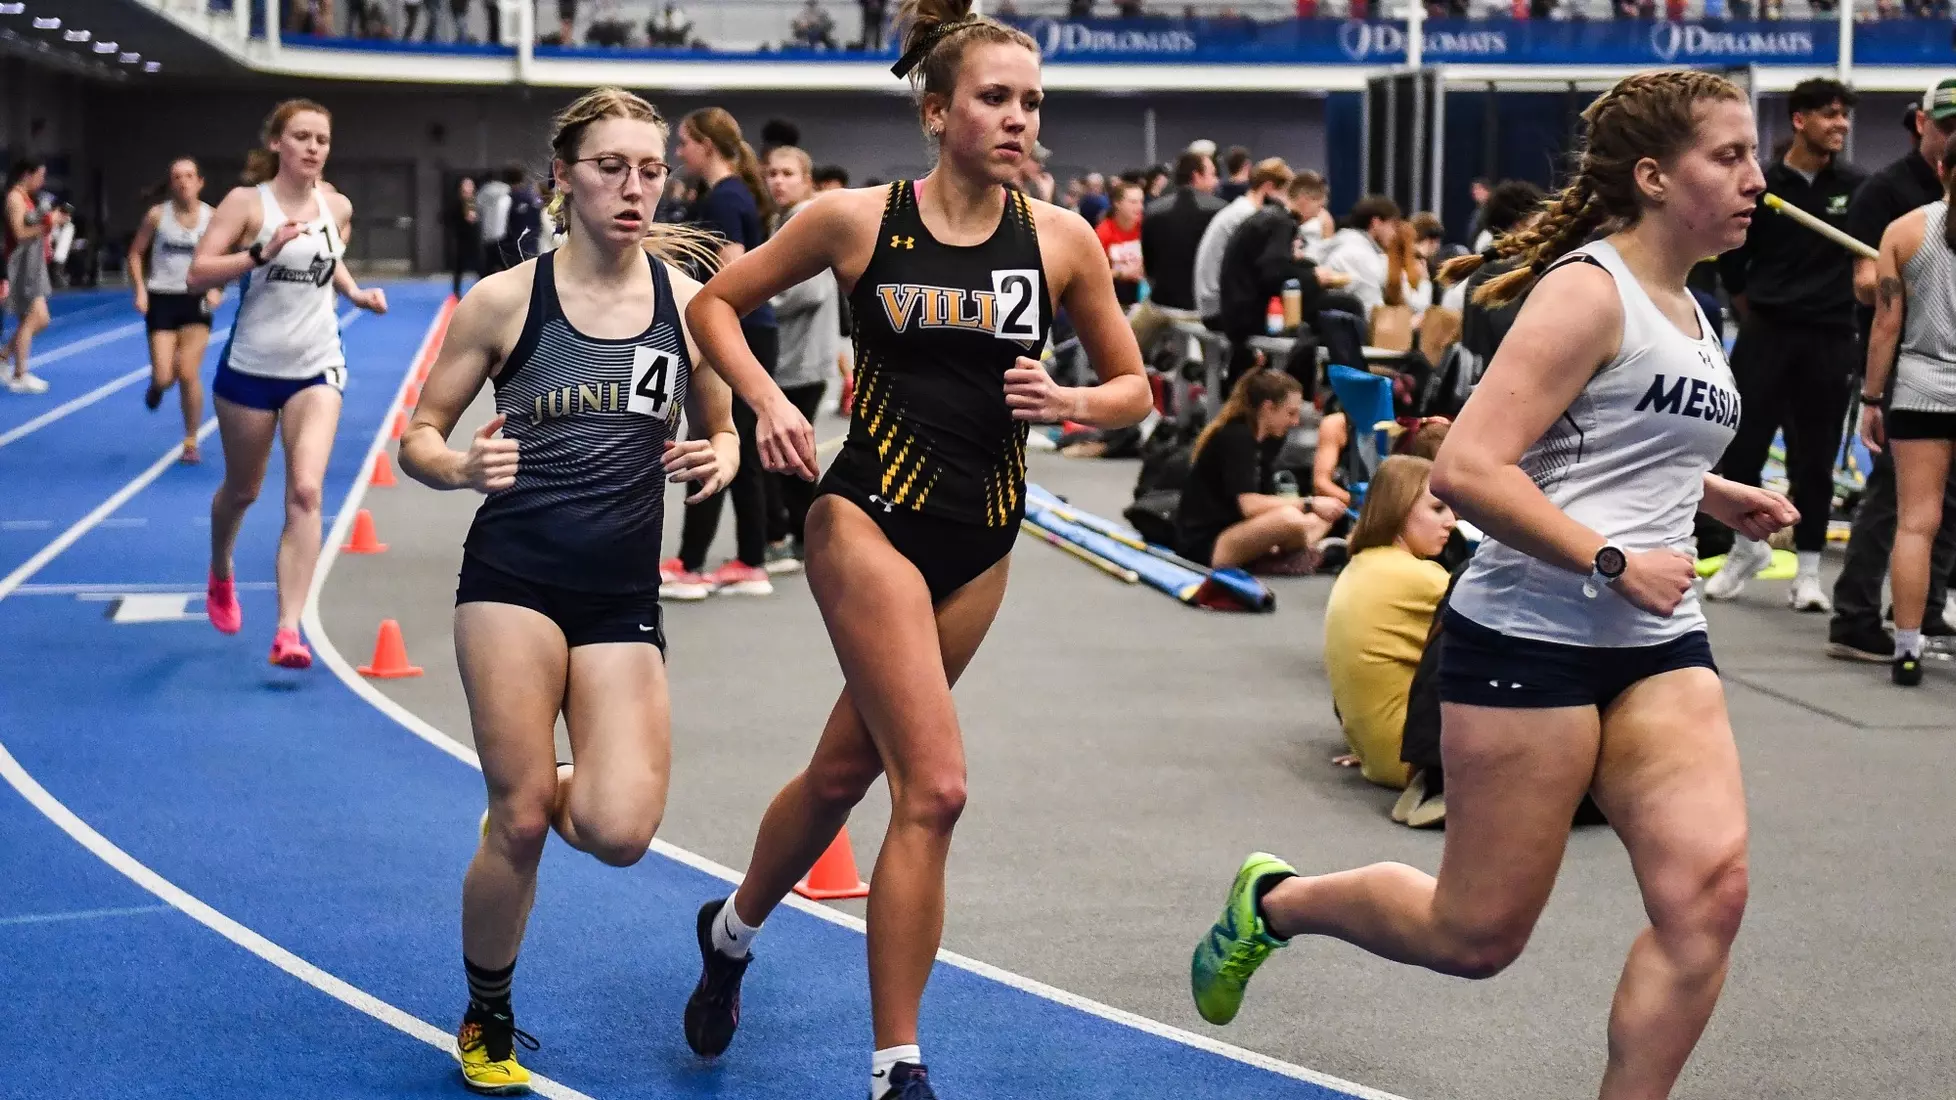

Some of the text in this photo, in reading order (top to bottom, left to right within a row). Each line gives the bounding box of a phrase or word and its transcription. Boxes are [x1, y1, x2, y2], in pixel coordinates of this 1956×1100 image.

[1374, 25, 1508, 54] DILOMATS
[320, 224, 334, 253] 1
[1000, 275, 1034, 335] 2
[529, 382, 681, 432] JUNIA
[635, 355, 669, 413] 4
